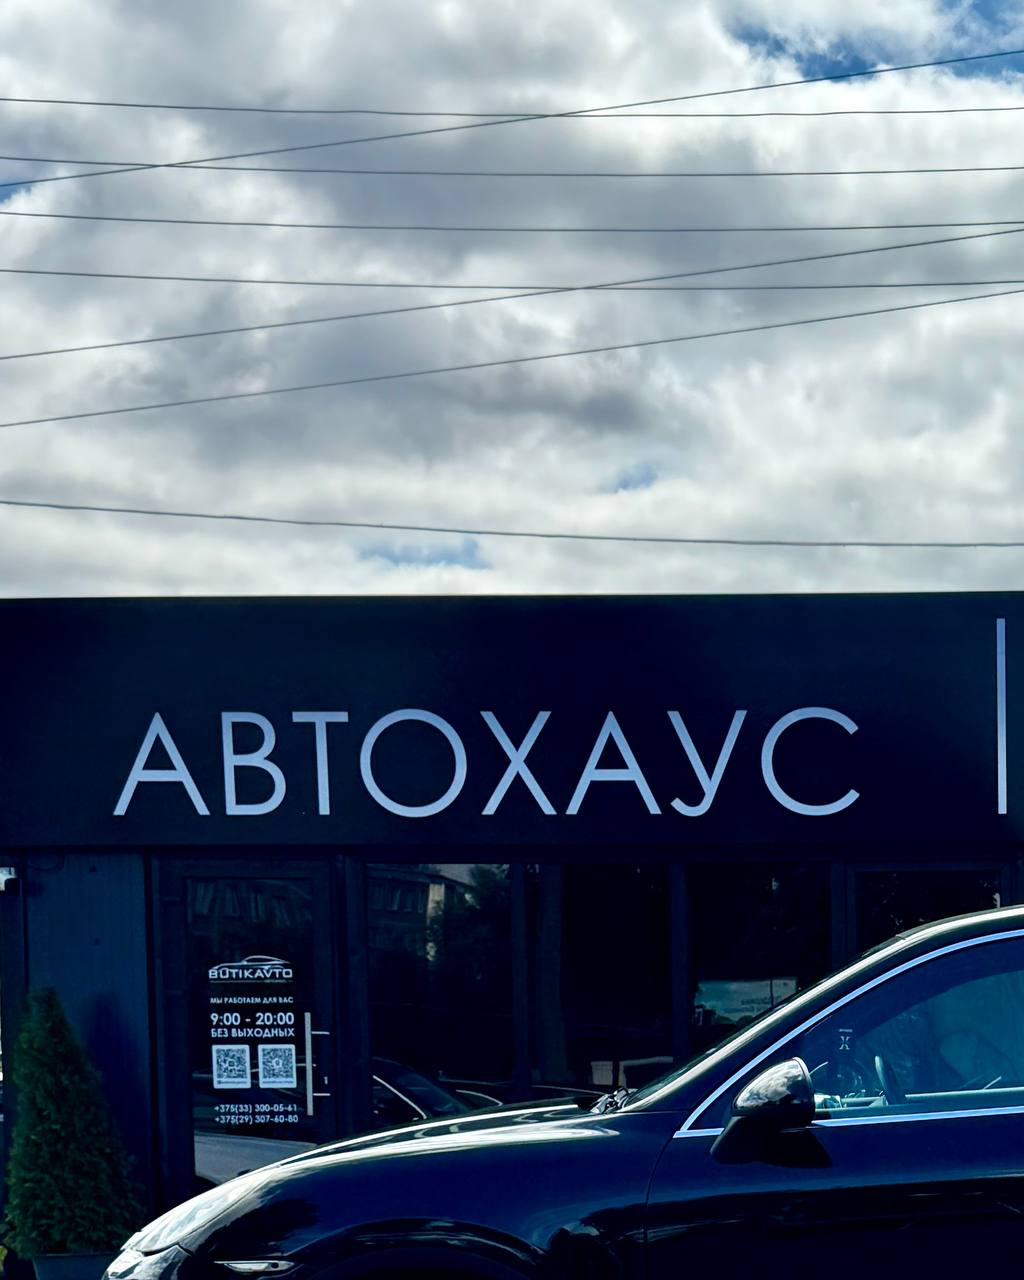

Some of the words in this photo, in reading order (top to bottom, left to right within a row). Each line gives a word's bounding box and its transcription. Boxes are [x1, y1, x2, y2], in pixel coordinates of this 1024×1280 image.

[113, 706, 861, 818] АВТОХАУС
[208, 968, 293, 979] BUTIKAVTO
[210, 1012, 241, 1026] 9:00
[255, 1012, 295, 1025] 20:00
[211, 1028, 229, 1038] БЕЗ
[231, 1028, 295, 1038] ВЫХОДНЫХ
[214, 1104, 252, 1113] +375(33)
[214, 1115, 253, 1125] +375(29)
